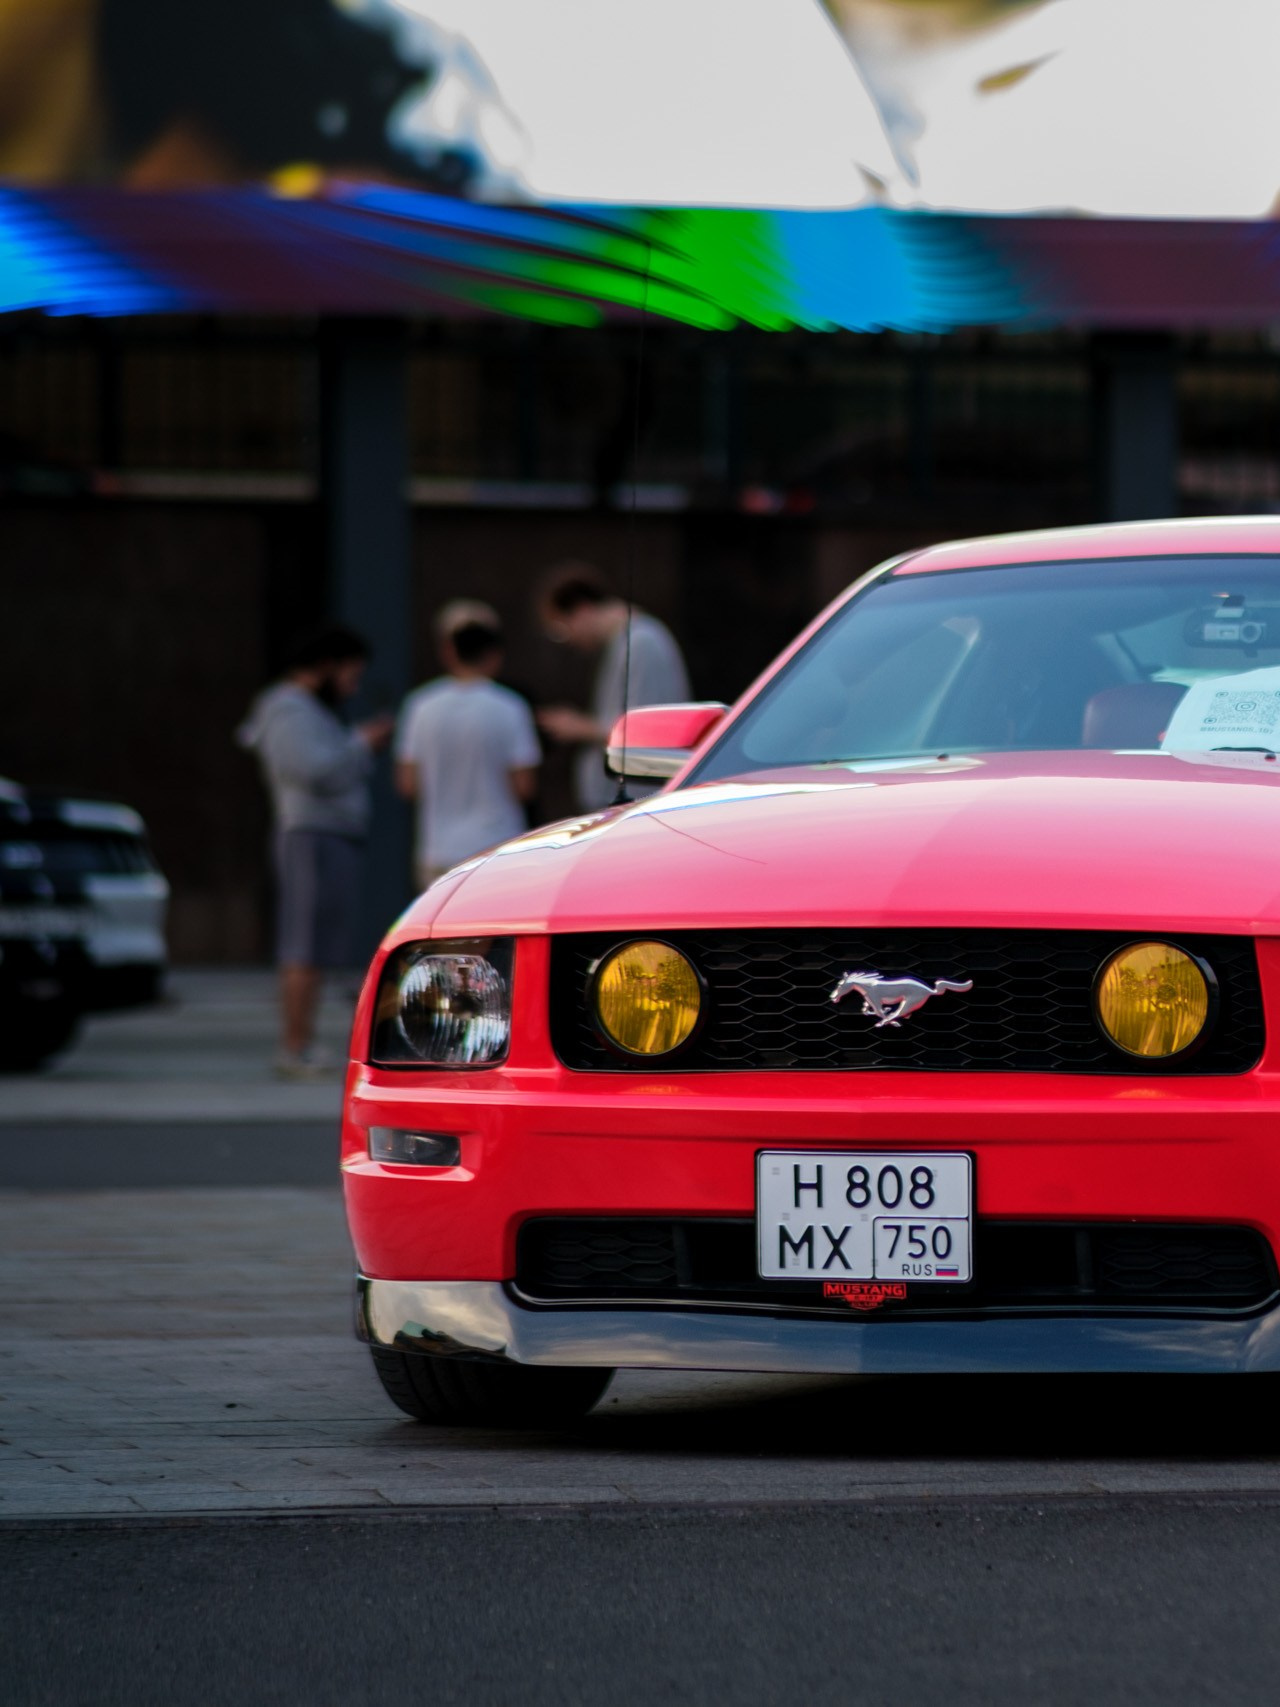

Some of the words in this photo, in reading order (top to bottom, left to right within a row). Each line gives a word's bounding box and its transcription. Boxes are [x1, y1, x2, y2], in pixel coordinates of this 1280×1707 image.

[793, 1164, 823, 1208] H
[846, 1165, 935, 1209] 808
[778, 1225, 852, 1270] MX
[882, 1224, 952, 1259] 750
[902, 1264, 933, 1276] RUS
[827, 1283, 903, 1296] MUSTANG
